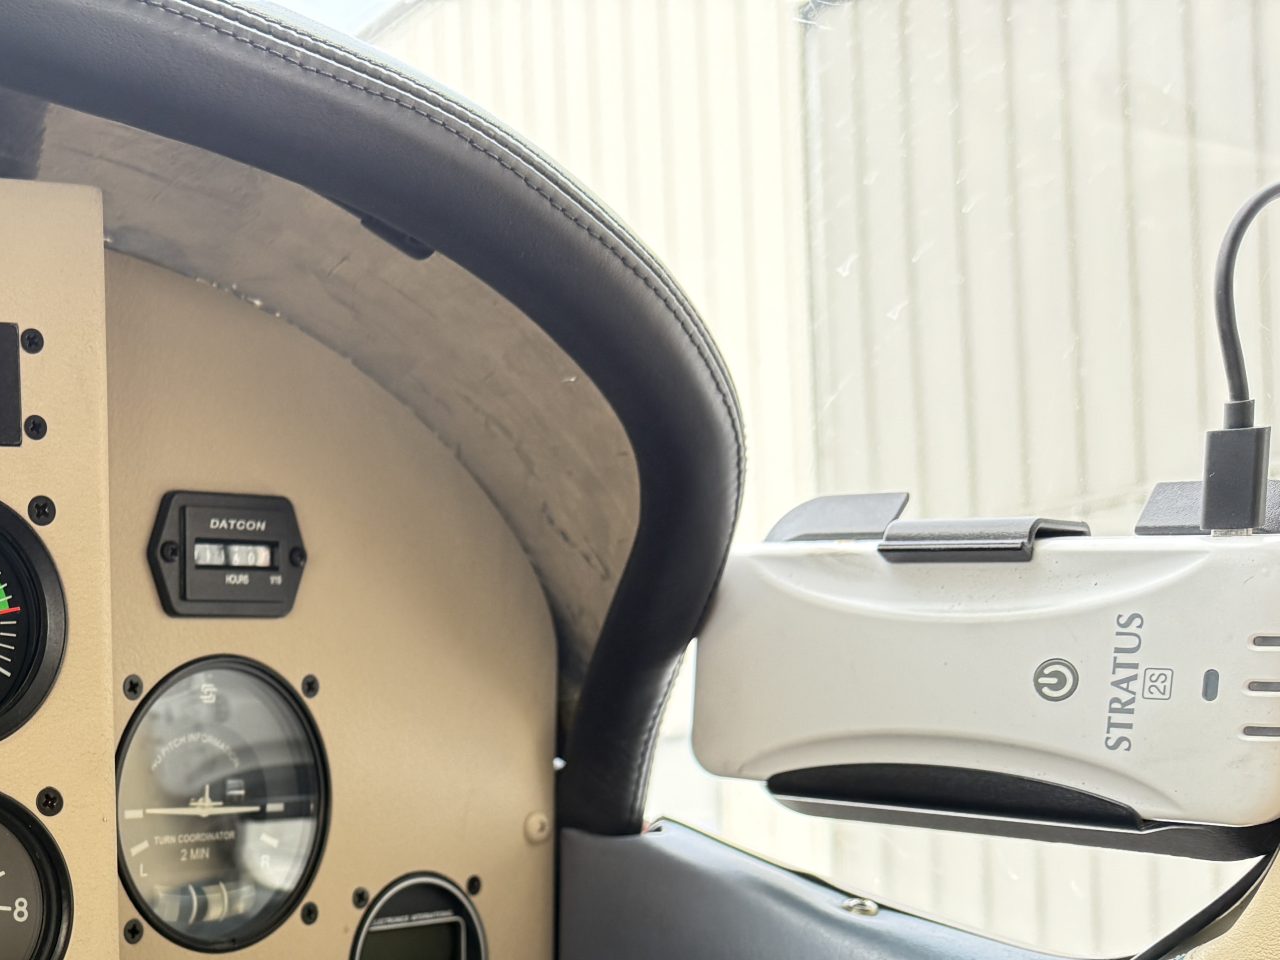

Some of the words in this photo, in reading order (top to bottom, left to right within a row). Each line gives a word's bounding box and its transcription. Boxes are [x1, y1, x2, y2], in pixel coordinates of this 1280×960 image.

[210, 518, 267, 531] DATCON
[1105, 612, 1144, 752] STRATUS
[1148, 672, 1168, 696] 2S
[154, 835, 176, 845] TURN
[190, 848, 210, 859] MIN
[13, 898, 28, 922] 8
